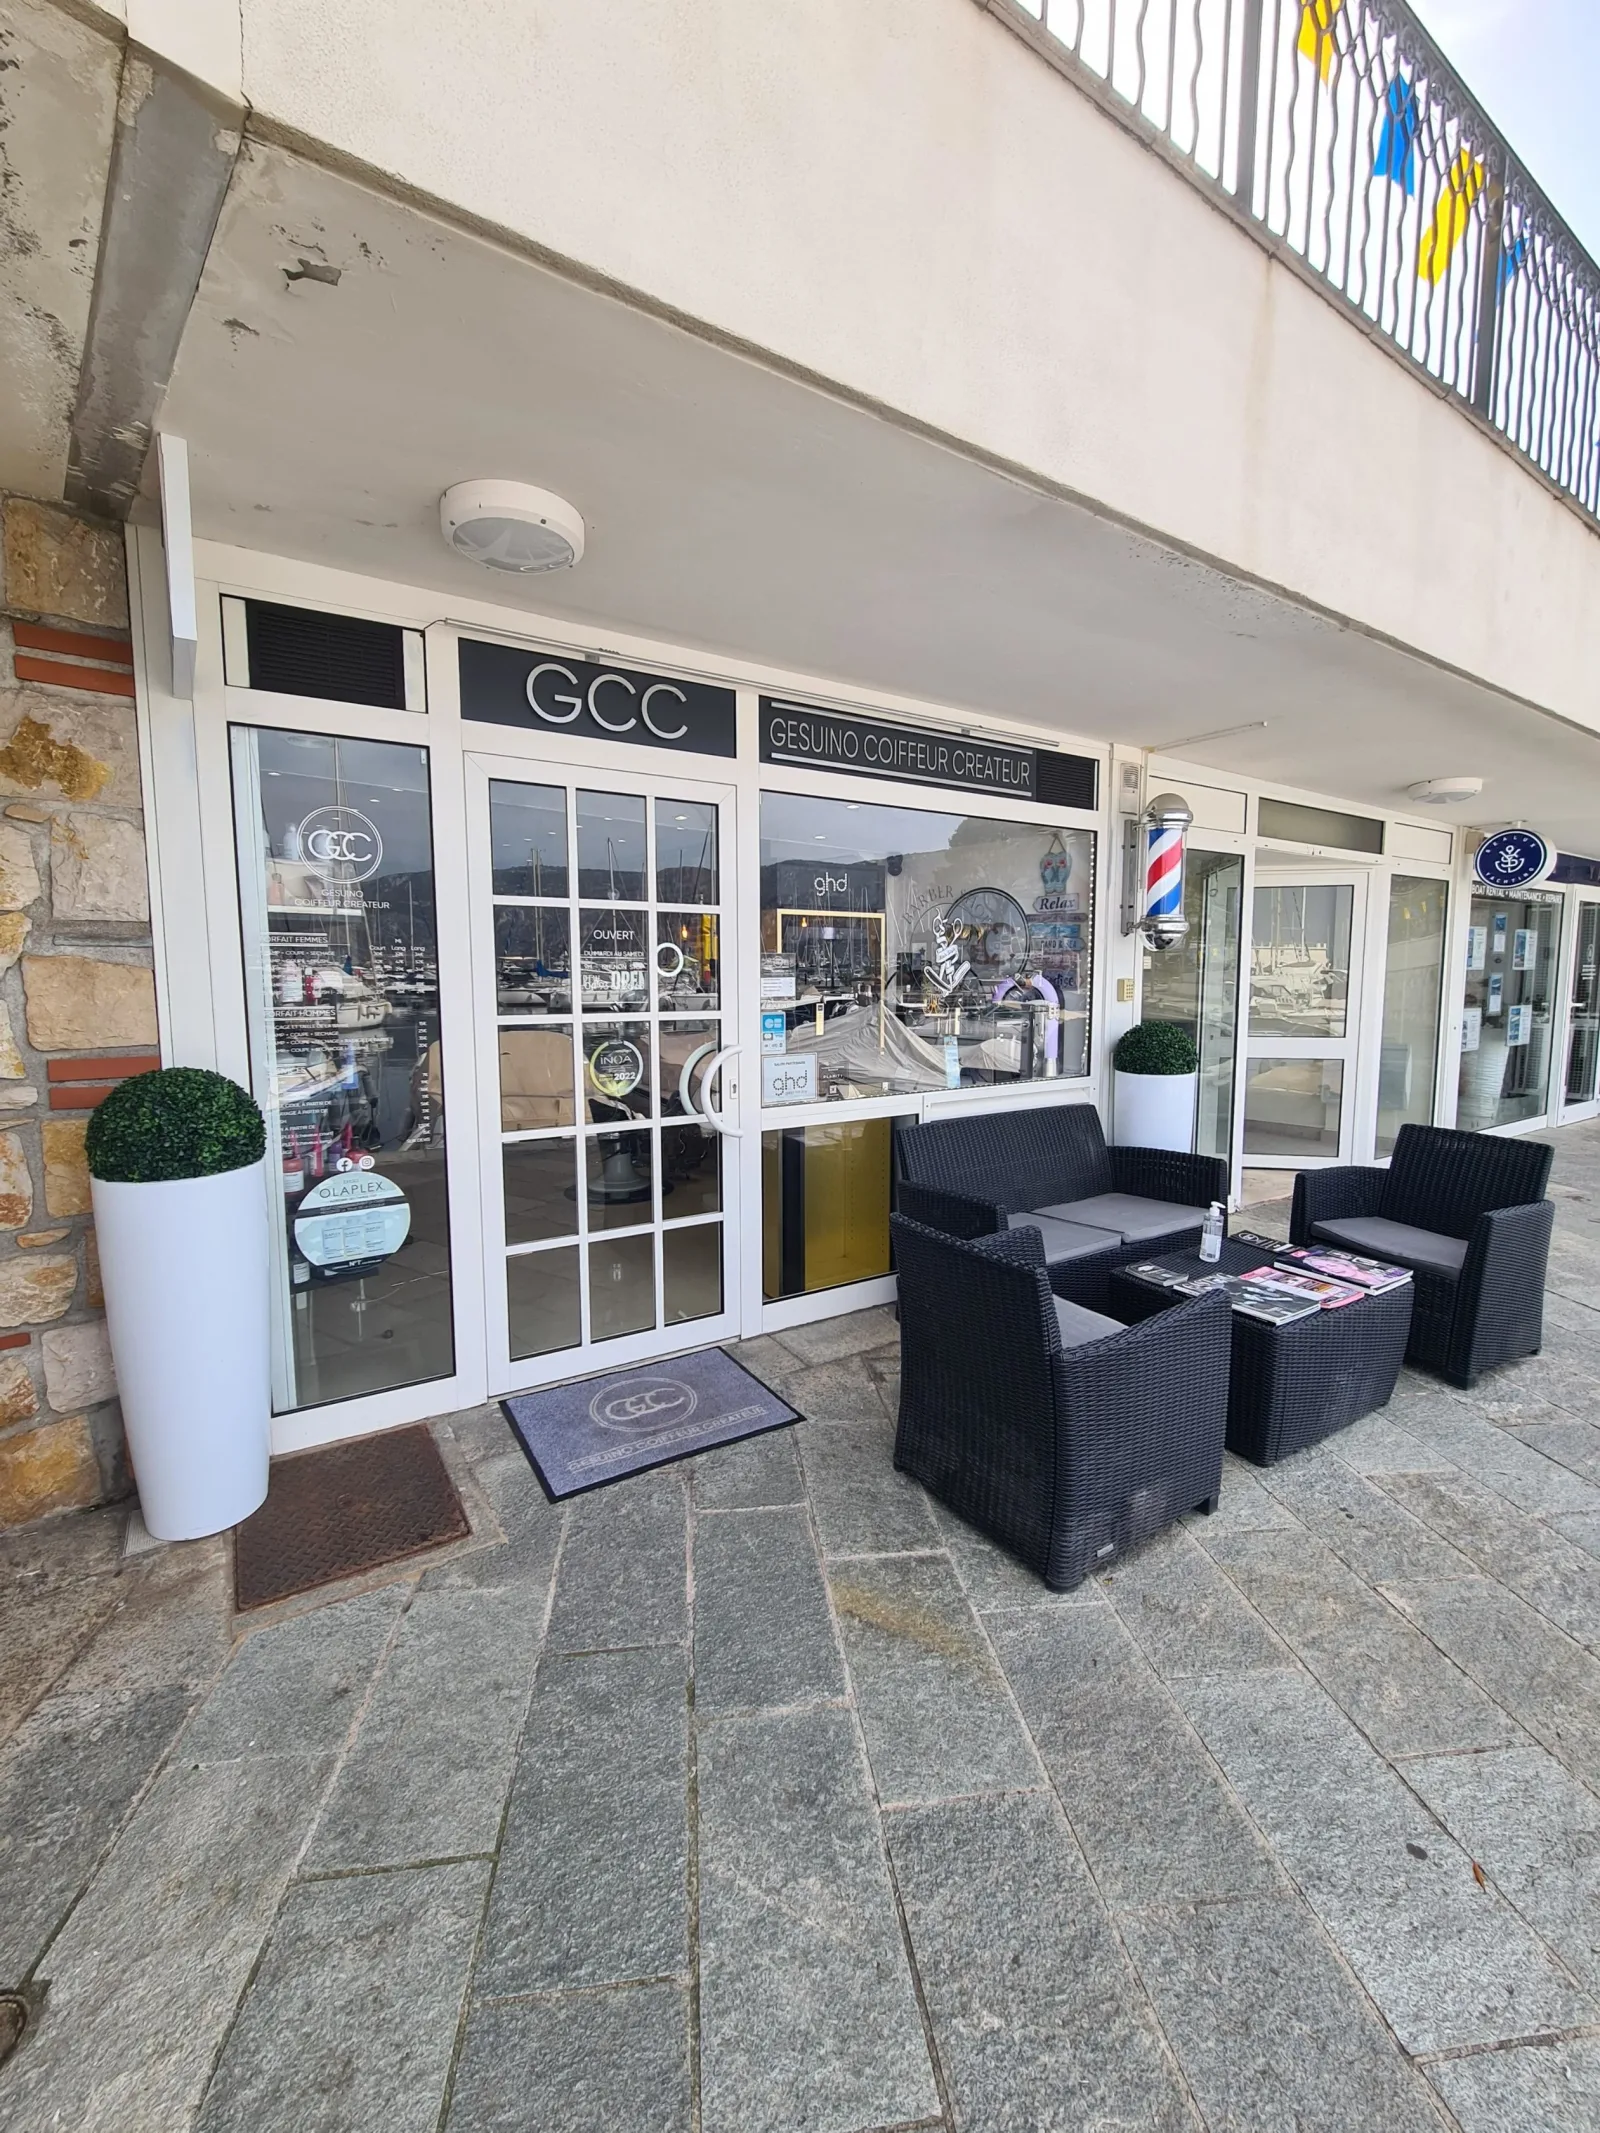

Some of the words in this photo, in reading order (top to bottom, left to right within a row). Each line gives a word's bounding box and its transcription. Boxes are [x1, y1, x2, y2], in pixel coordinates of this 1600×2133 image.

[526, 663, 688, 740] GCC
[769, 717, 859, 758] GESUINO
[863, 735, 948, 773] COIFFEUR
[952, 750, 1030, 786] CREATEUR
[814, 871, 847, 897] ghd
[1471, 884, 1484, 895] BOAT
[1486, 886, 1505, 897] RENTAL
[1509, 889, 1542, 901] MAINTENANCE
[321, 889, 364, 898] GESUINO
[294, 898, 341, 908] COIFFEUR
[343, 899, 390, 909] CREATEUR
[902, 885, 954, 925] BARBER
[1038, 896, 1076, 911] Relax
[295, 936, 329, 944] FEMMES
[593, 930, 635, 941] OUVERT
[299, 1009, 336, 1017] HOMMES
[613, 1072, 636, 1081] 2022
[773, 1069, 808, 1097] ghd
[319, 1181, 384, 1199] OLAPLEX
[567, 1445, 634, 1473] GESUINO
[636, 1426, 701, 1449] COIFFEUR
[702, 1405, 768, 1431] CREATEUR
